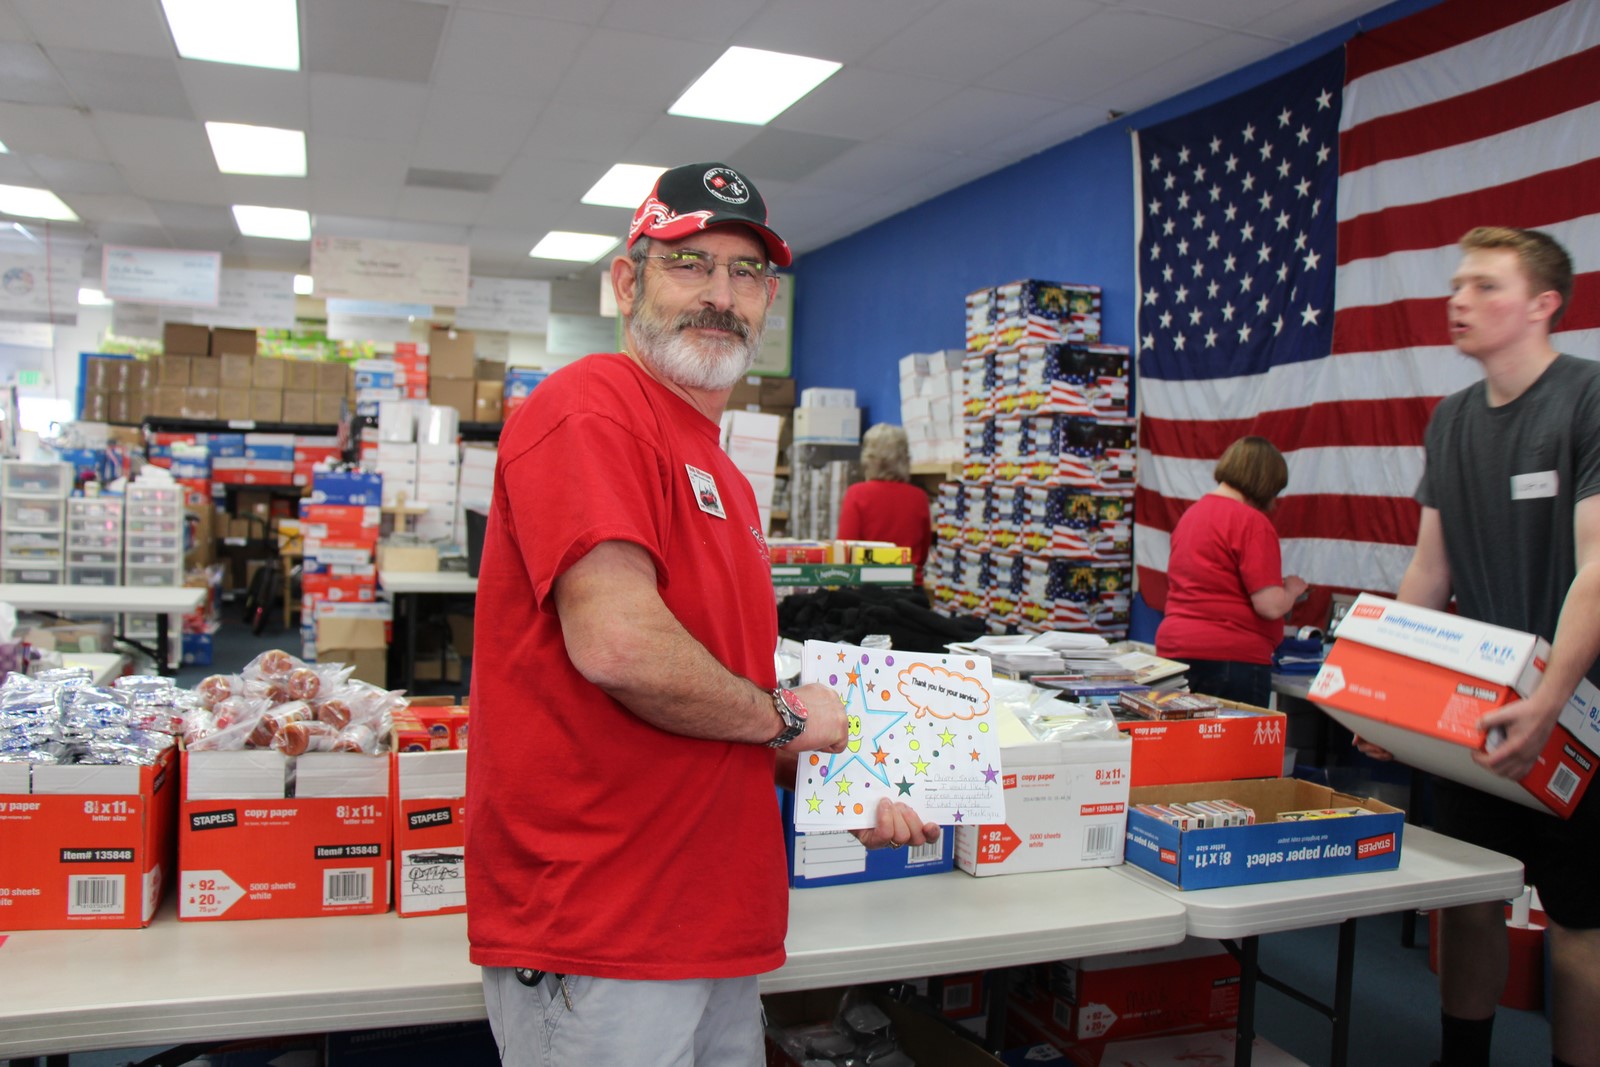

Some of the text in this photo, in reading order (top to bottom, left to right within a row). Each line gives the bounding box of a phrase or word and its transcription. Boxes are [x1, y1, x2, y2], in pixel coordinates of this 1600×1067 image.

[1384, 614, 1437, 635] multipurpose
[1438, 626, 1464, 641] paper
[912, 677, 927, 688] Thank
[928, 683, 937, 692] you
[946, 689, 958, 698] your
[1150, 726, 1168, 735] paper
[1214, 724, 1222, 733] 11
[1112, 768, 1120, 778] 11
[10, 802, 40, 812] paper
[102, 803, 110, 813] x
[112, 801, 127, 813] 11
[352, 808, 360, 817] x
[361, 805, 374, 817] 11
[244, 809, 298, 818] copy paper
[193, 813, 235, 826] STAPLES
[410, 812, 450, 826] STAPLES
[989, 831, 1001, 841] 92
[317, 846, 378, 856] item# 135848
[988, 843, 1000, 854] 20
[1358, 838, 1391, 854] STAPLES
[63, 851, 132, 860] item# 135848
[1195, 853, 1208, 868] 11
[1210, 852, 1218, 861] x
[1246, 844, 1352, 868] copy paper select
[199, 880, 215, 890] 92
[271, 882, 296, 890] sheets
[11, 888, 40, 896] sheets
[250, 892, 272, 900] white
[199, 894, 215, 905] 20
